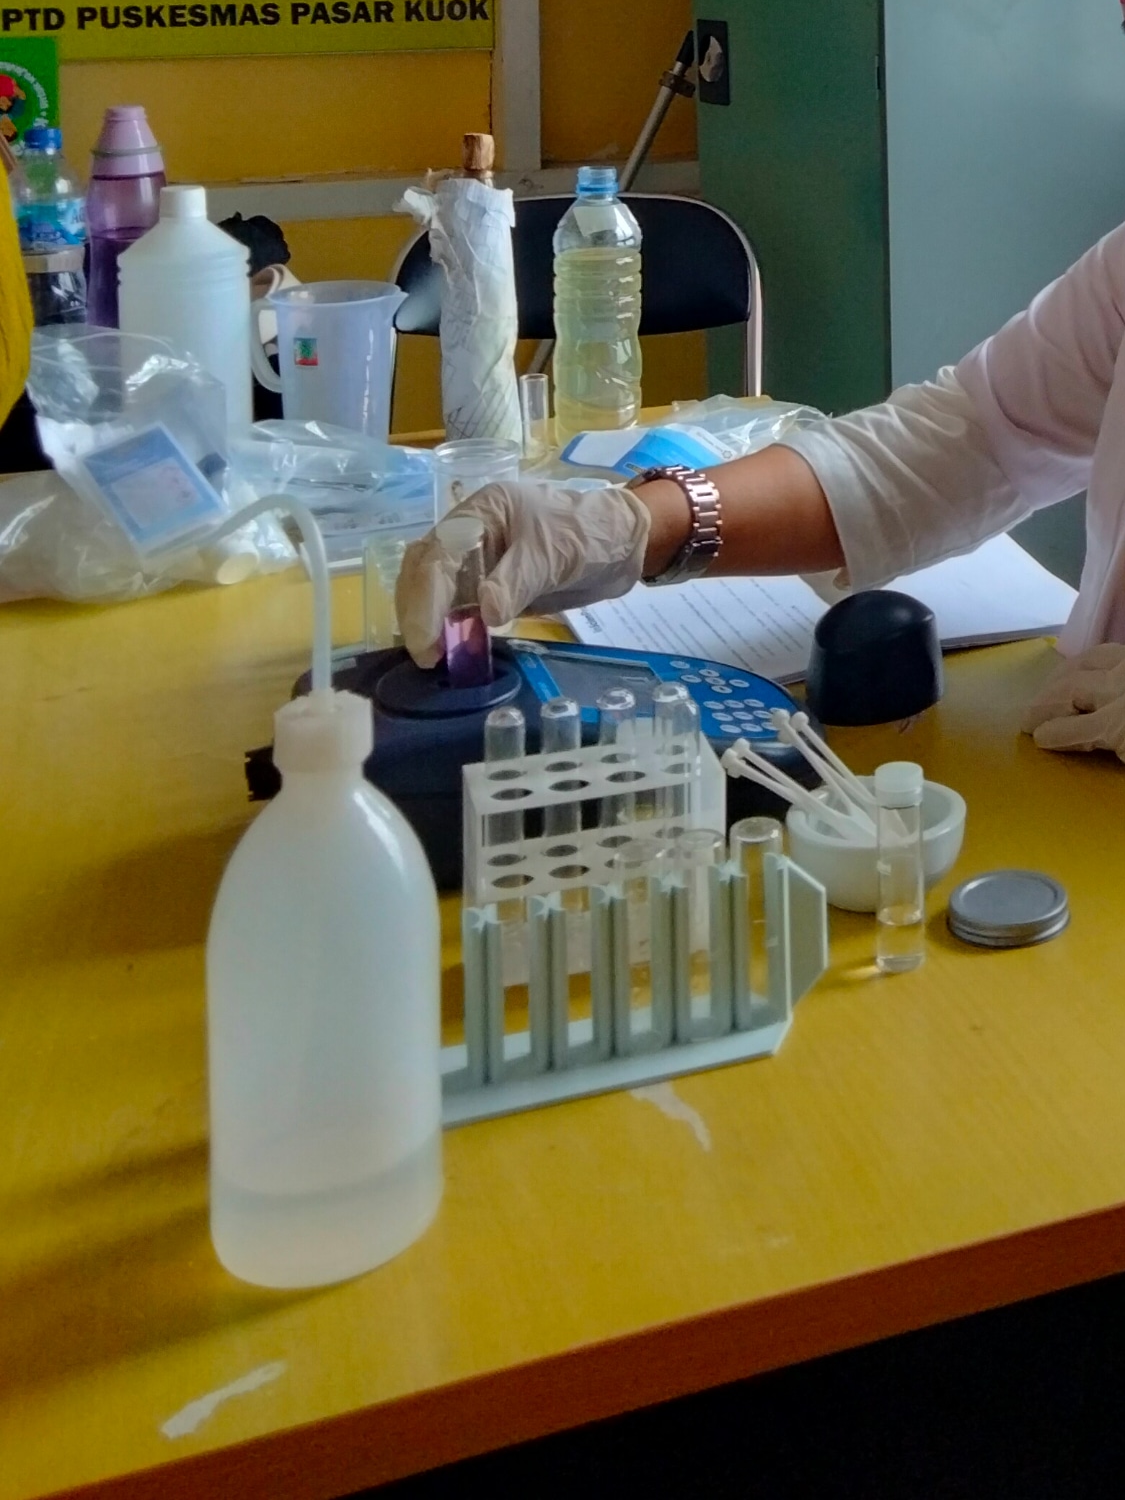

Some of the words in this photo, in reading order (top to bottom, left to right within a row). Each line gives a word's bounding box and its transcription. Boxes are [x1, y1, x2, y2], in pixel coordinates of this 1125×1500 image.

[2, 7, 65, 32] PTD
[77, 2, 281, 30] PUSKESMAS
[291, 0, 394, 25] PASAR
